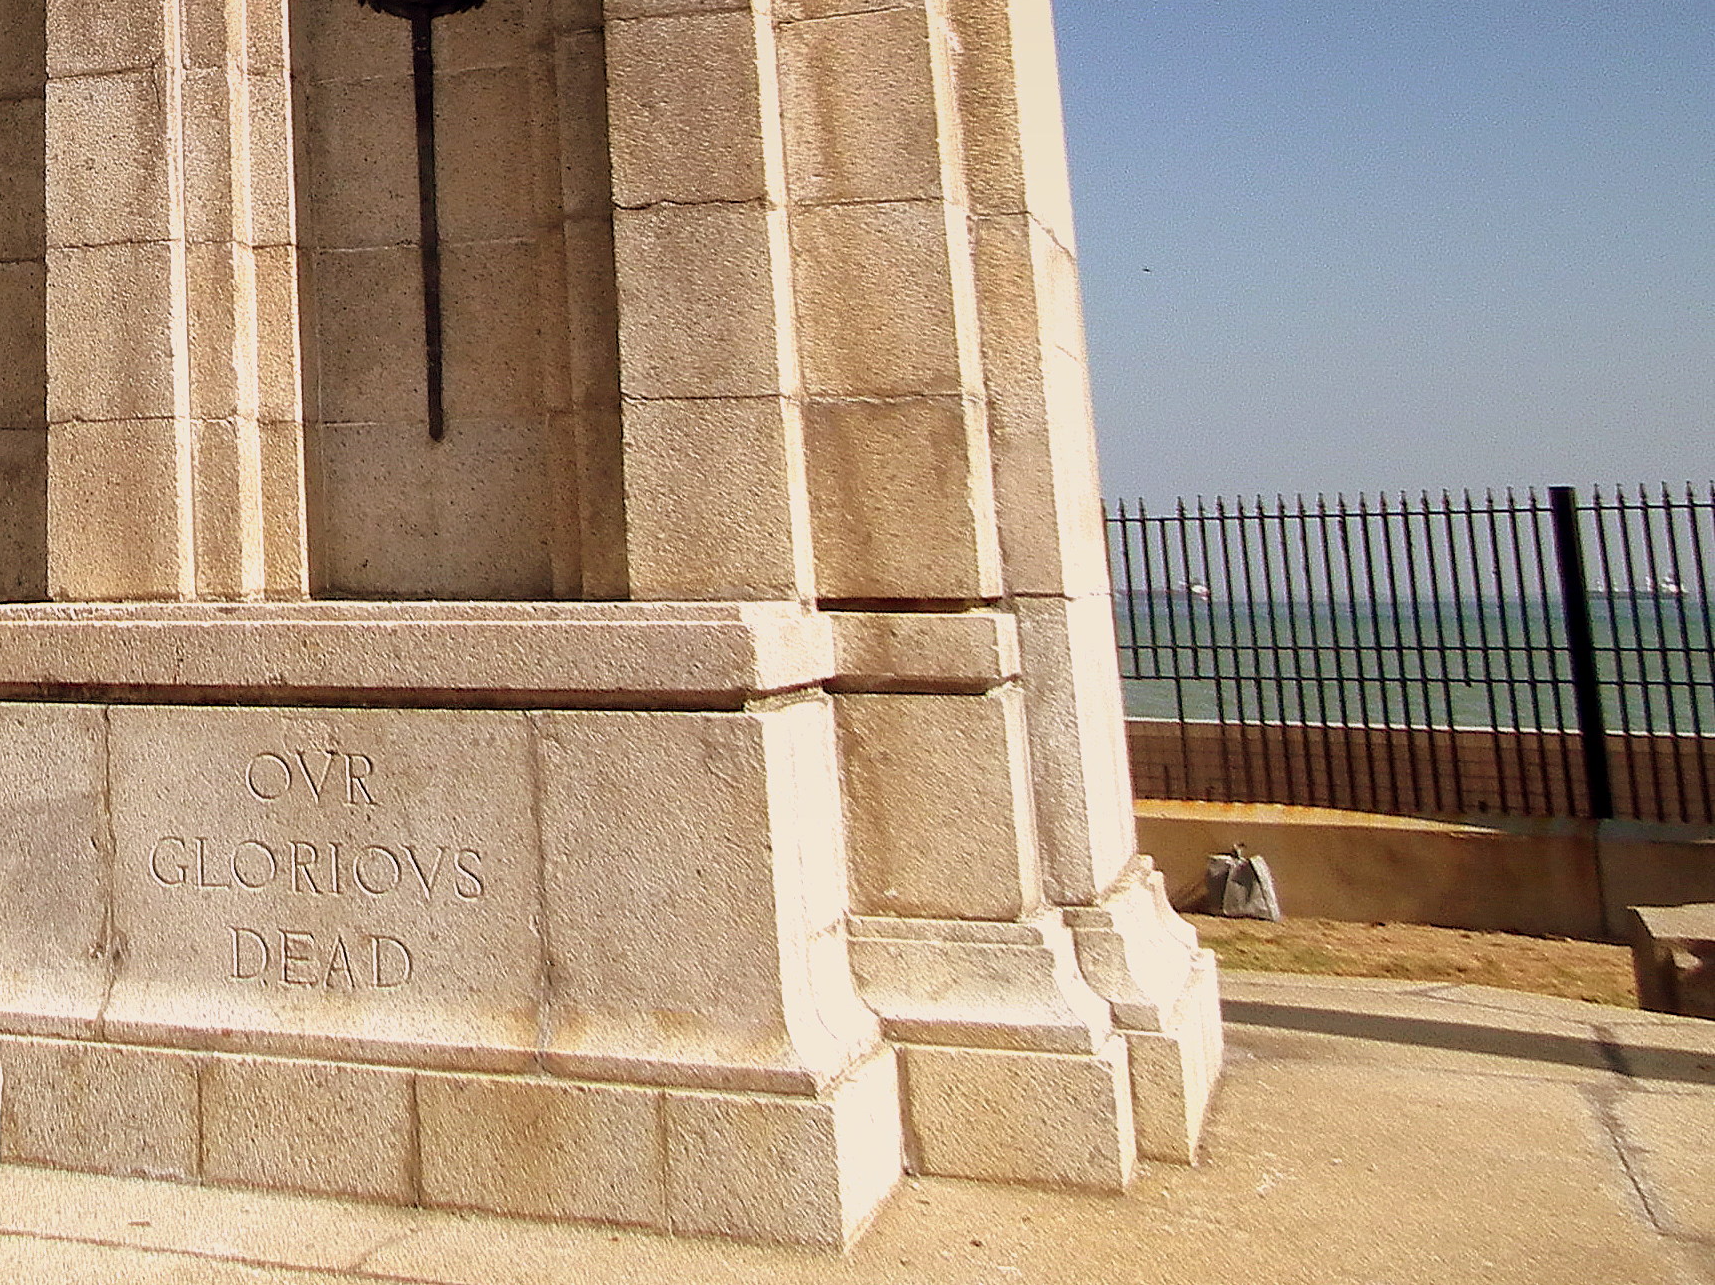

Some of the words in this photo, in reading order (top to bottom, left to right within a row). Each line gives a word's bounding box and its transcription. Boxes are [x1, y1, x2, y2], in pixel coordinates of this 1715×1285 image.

[245, 751, 379, 806] OVR
[148, 836, 488, 903] GLORIOVS
[227, 926, 414, 990] DEAD
